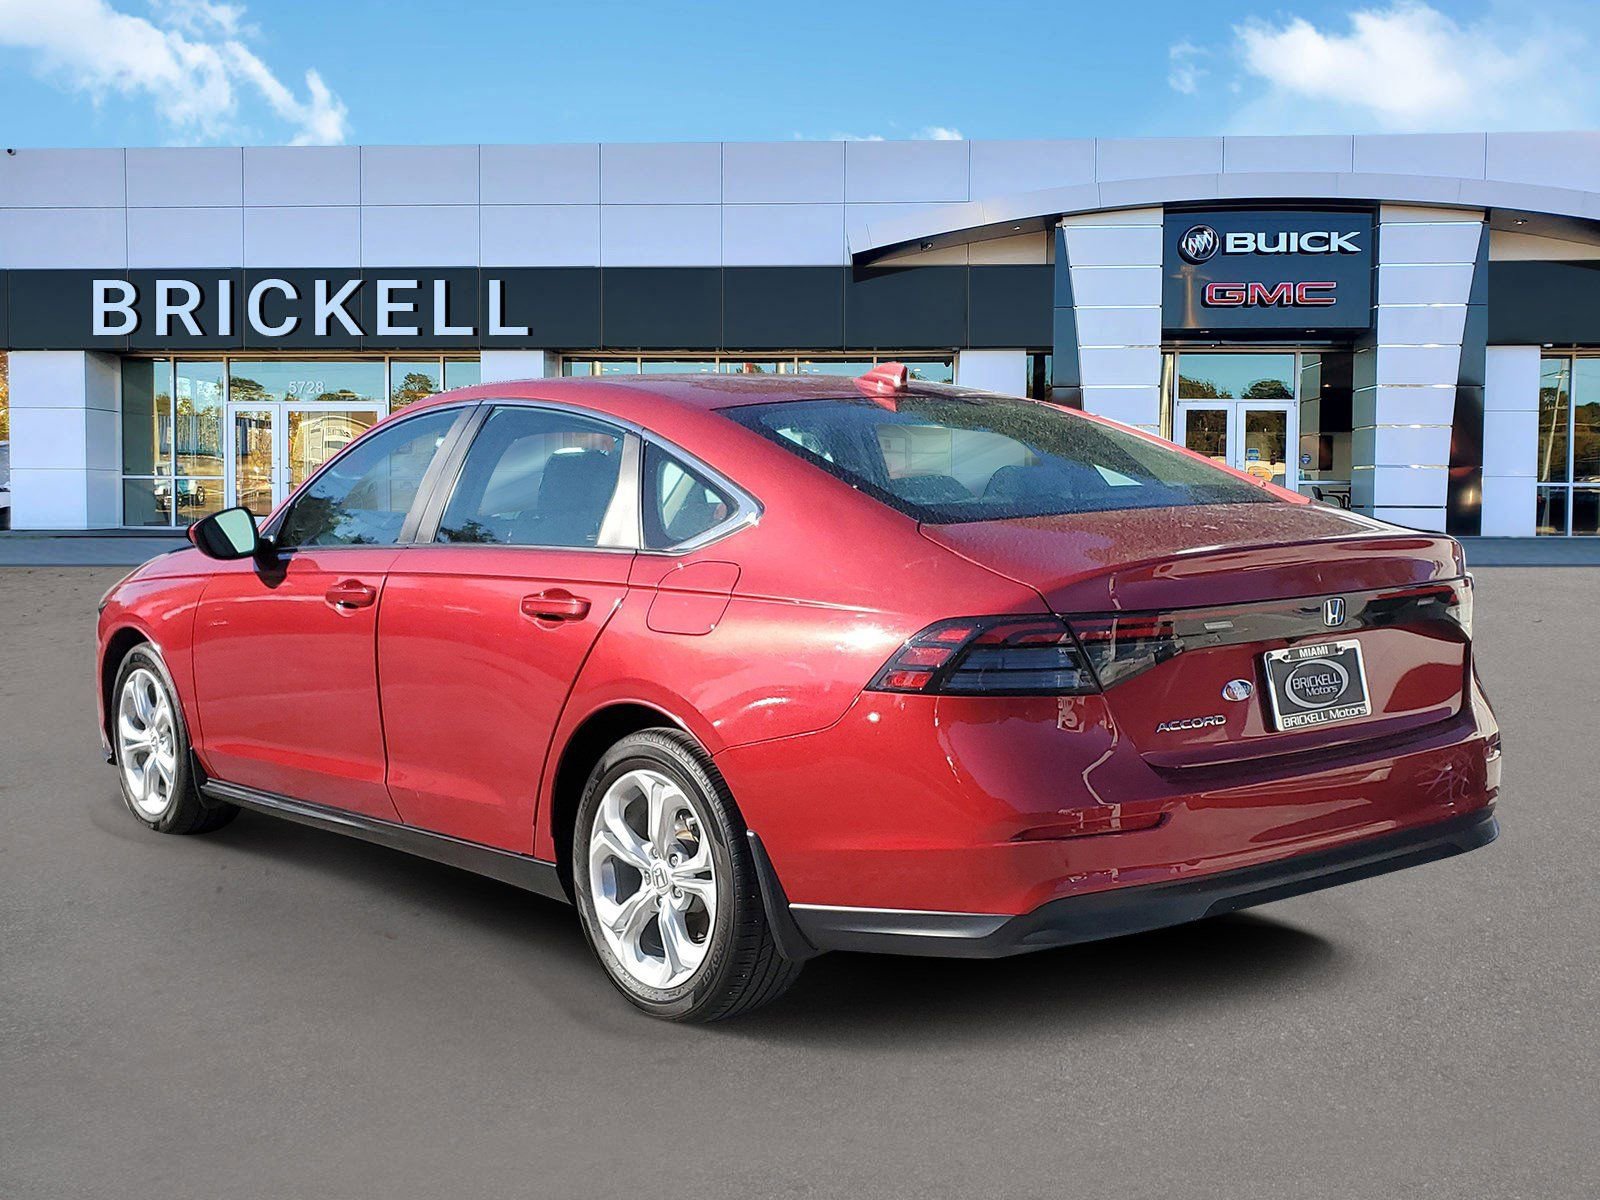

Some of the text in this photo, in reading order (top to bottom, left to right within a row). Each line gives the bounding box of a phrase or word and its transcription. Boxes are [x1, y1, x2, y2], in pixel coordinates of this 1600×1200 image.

[1226, 231, 1361, 253] BUICK
[1206, 281, 1337, 305] GMC
[92, 278, 531, 338] BRICKELL
[288, 380, 325, 395] 5728
[1299, 645, 1329, 659] MIAMI
[1292, 672, 1341, 691] BRICKELL
[1306, 684, 1338, 697] Motors
[1155, 714, 1228, 734] ACCORD
[1283, 705, 1367, 728] BRICKELL Motors
